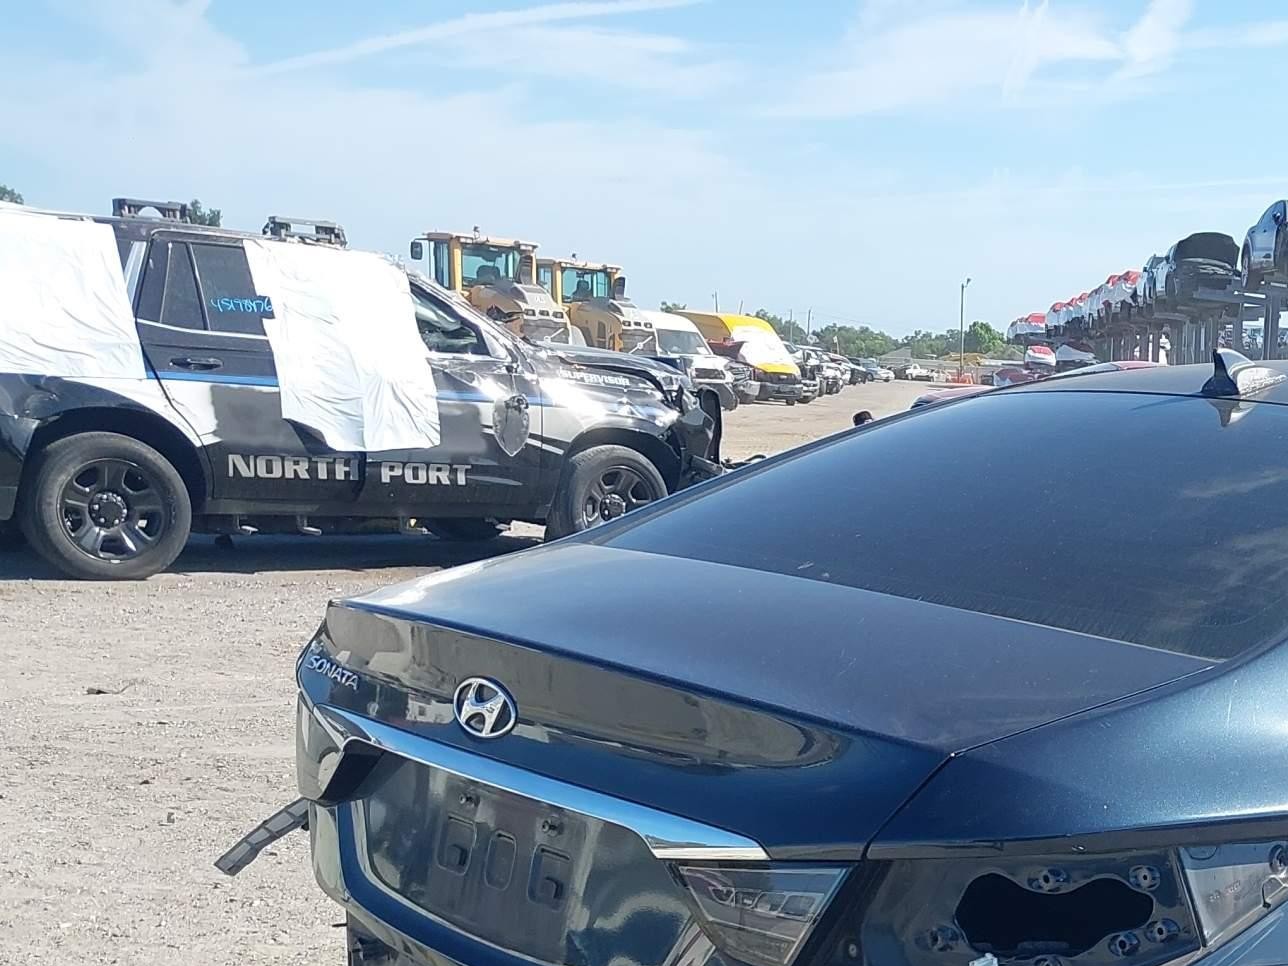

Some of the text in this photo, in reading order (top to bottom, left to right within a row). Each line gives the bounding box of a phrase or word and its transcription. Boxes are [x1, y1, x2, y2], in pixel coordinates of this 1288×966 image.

[228, 454, 472, 486] NORTH PORT
[305, 655, 358, 690] SONATA
